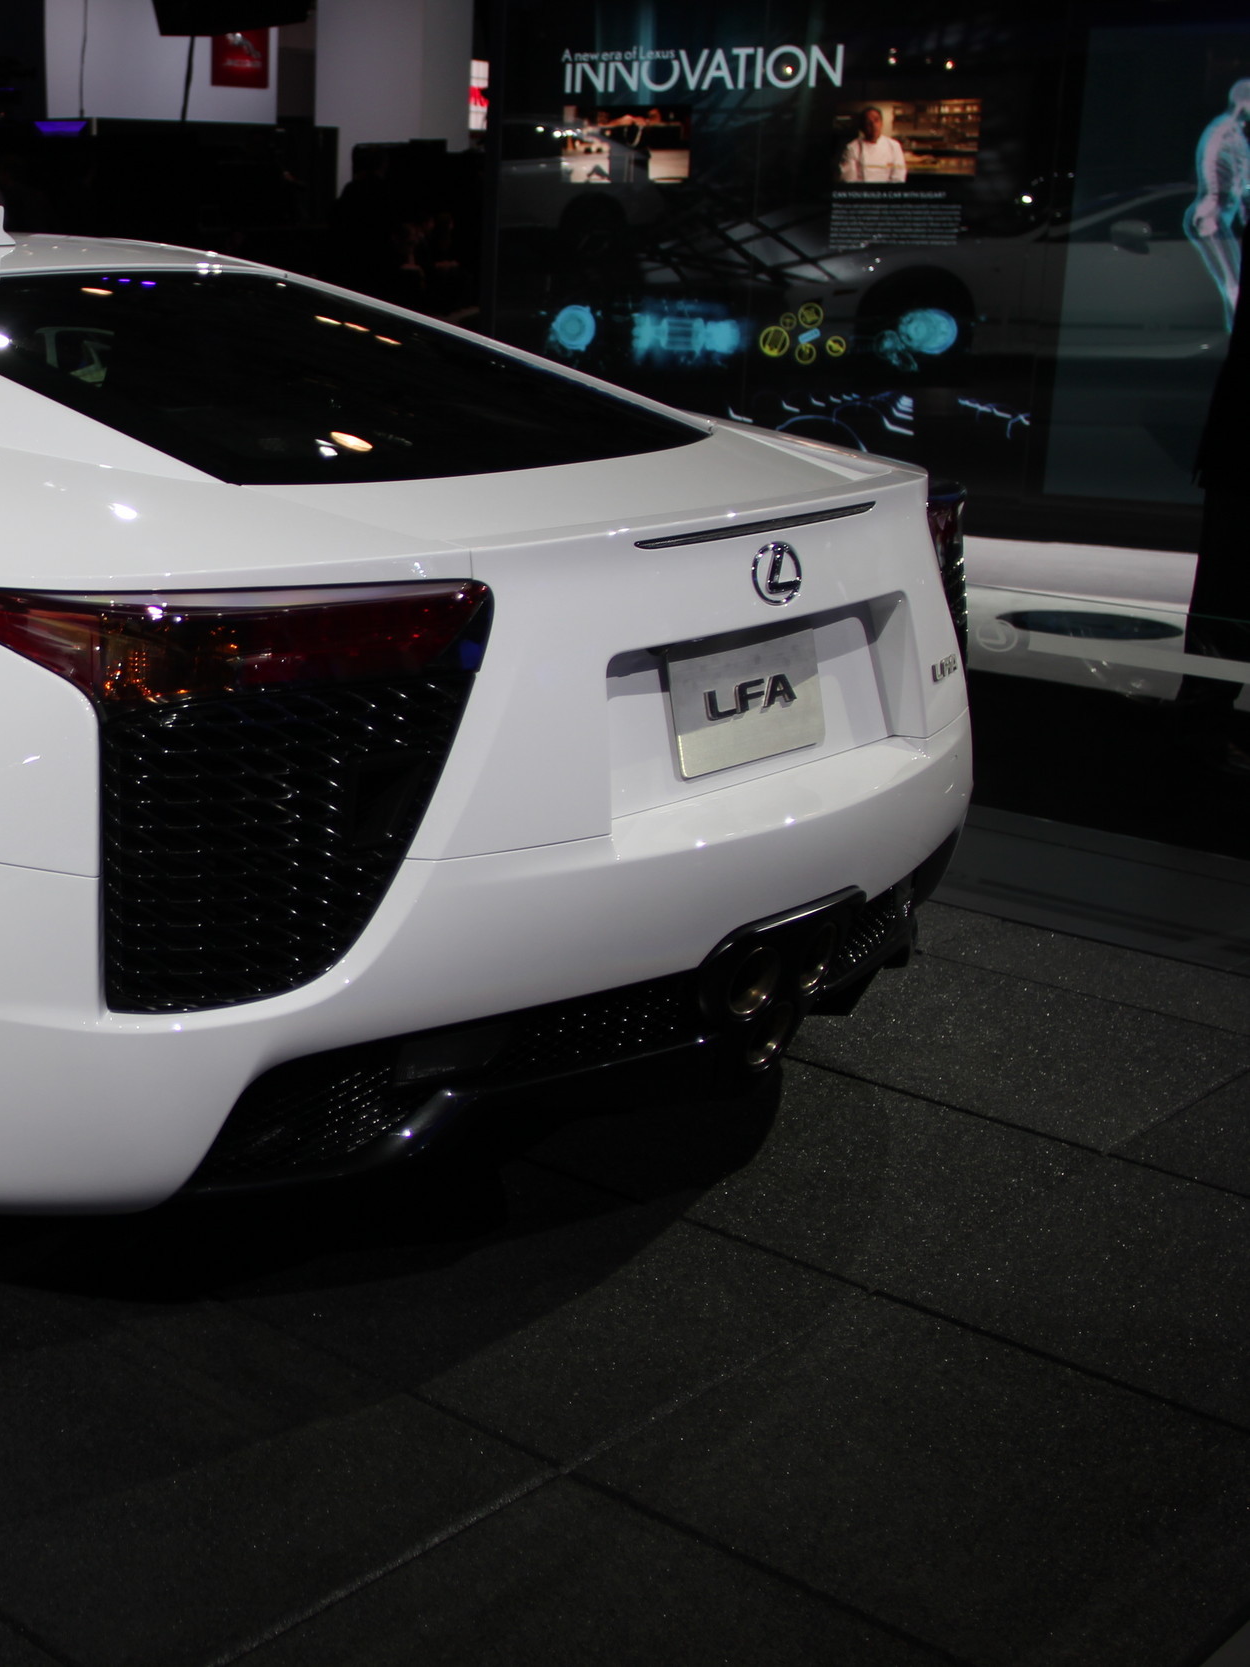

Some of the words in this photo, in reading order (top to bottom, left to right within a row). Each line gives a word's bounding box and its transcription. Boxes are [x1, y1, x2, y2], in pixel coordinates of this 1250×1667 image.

[561, 48, 573, 62] A
[574, 51, 598, 62] new
[600, 50, 623, 61] era
[623, 46, 638, 61] of
[639, 46, 676, 60] Lexus
[563, 43, 846, 94] INNOVATION
[703, 673, 797, 721] LFA
